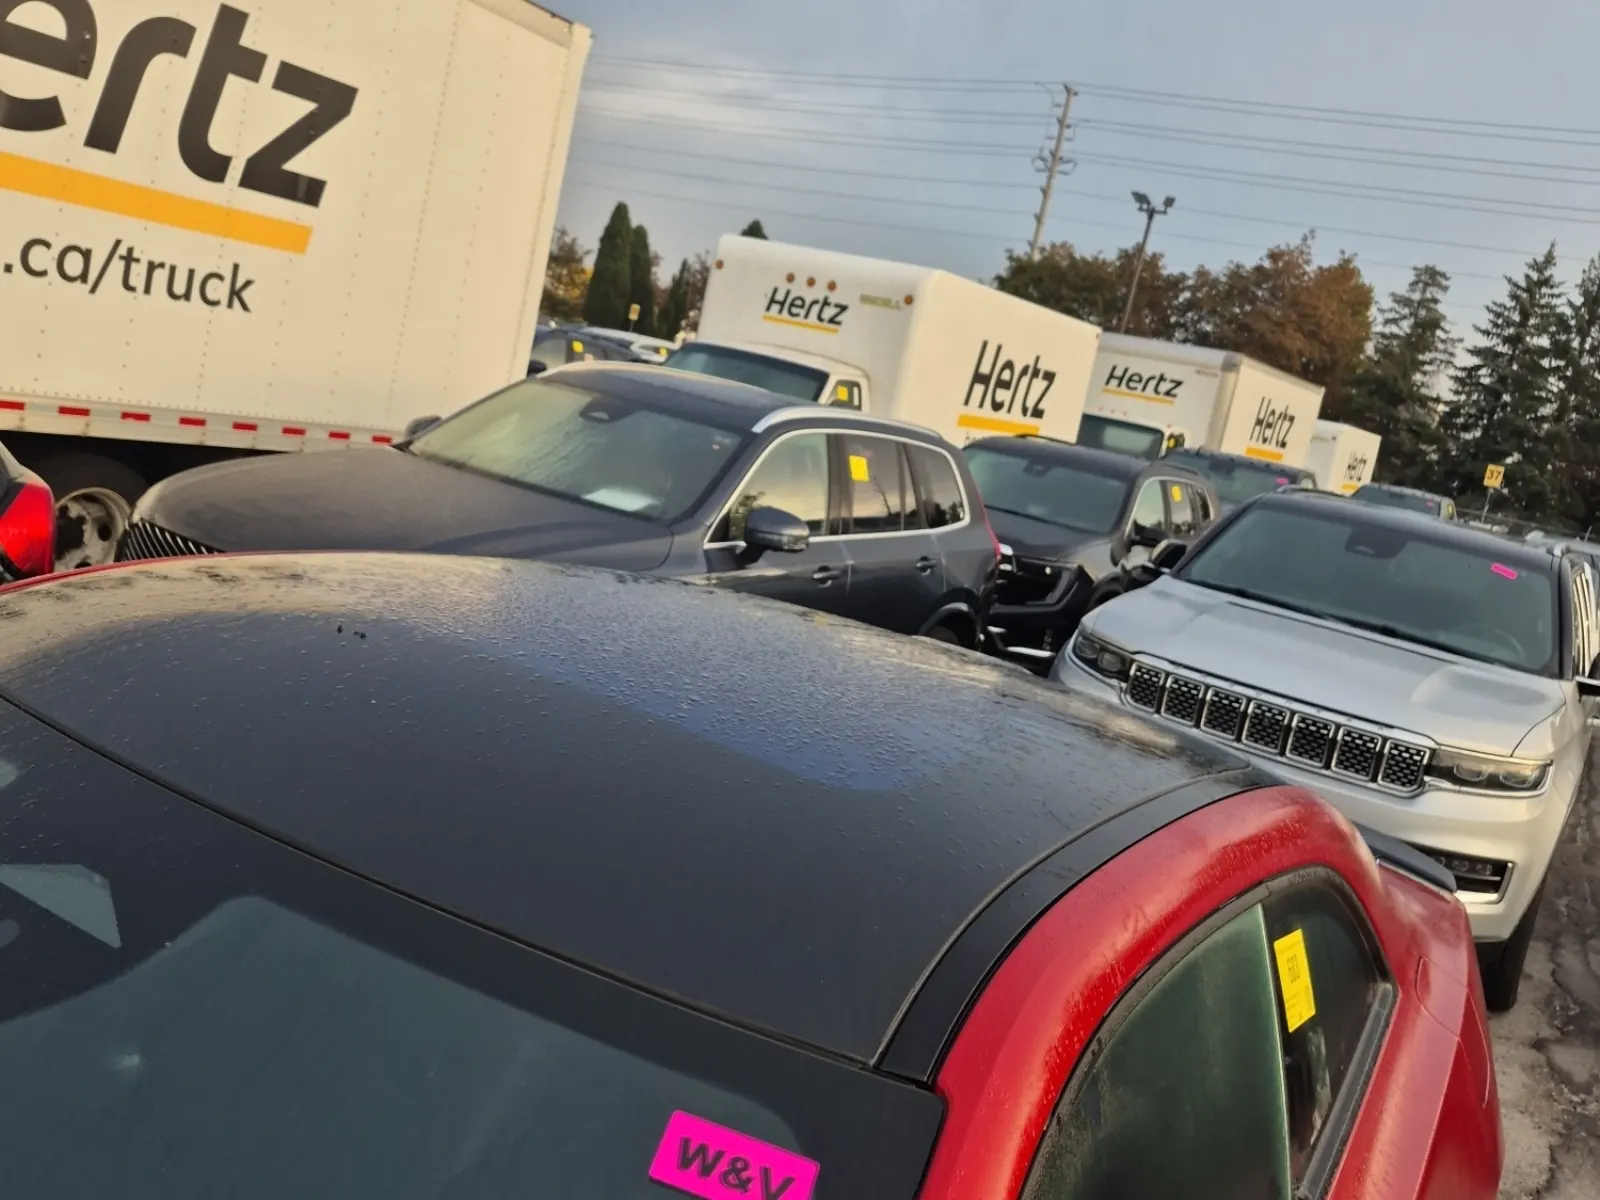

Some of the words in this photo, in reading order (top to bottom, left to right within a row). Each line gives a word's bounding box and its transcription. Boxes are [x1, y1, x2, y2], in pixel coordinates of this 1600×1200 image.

[3, 238, 254, 313] .ca/truck
[765, 286, 849, 326] Hertz
[963, 339, 1056, 419] Hertz
[1104, 364, 1184, 398] Hertz
[1249, 395, 1296, 449] Hertz
[1486, 468, 1502, 481] 37
